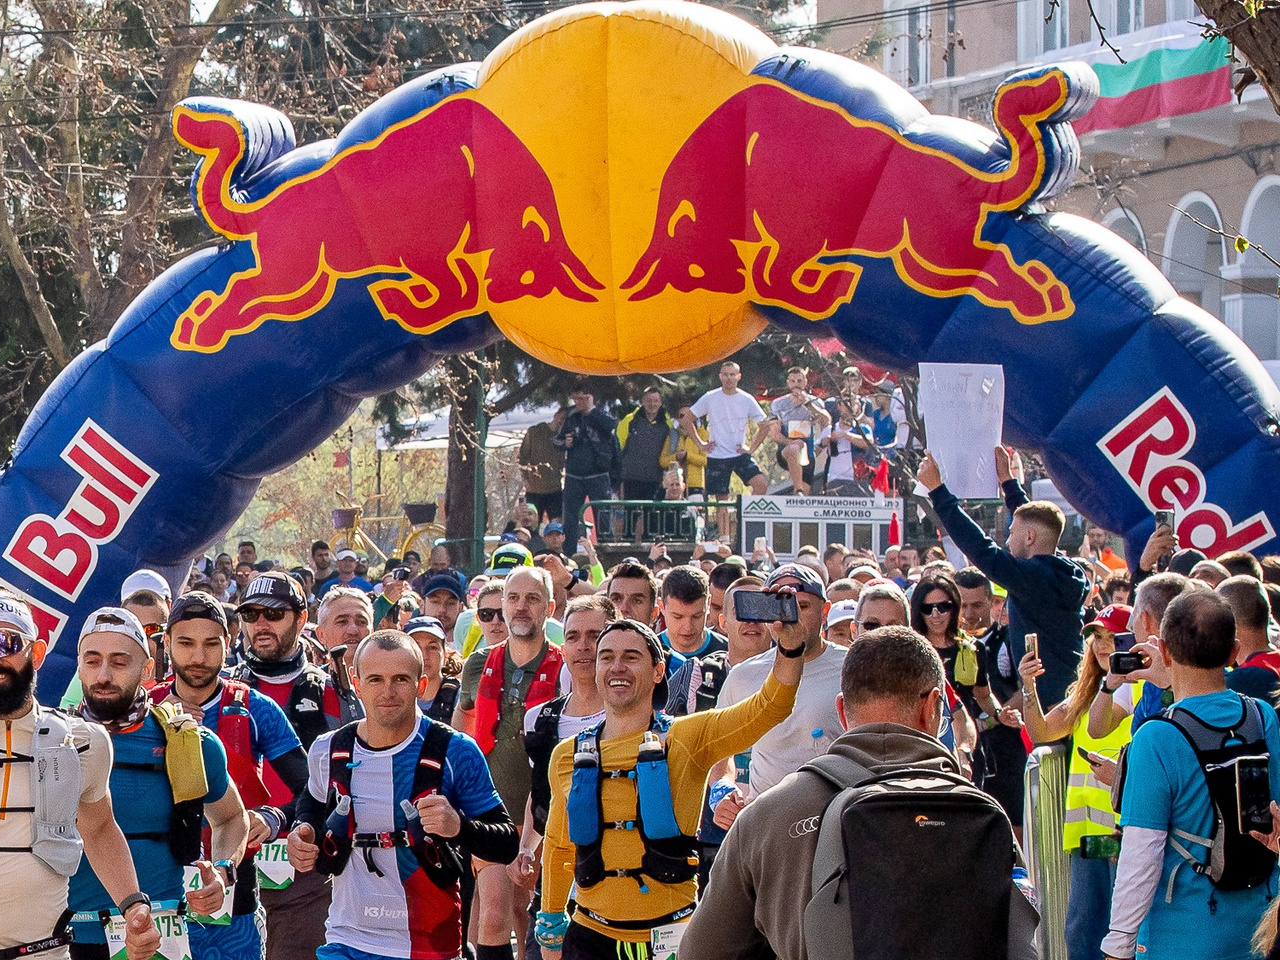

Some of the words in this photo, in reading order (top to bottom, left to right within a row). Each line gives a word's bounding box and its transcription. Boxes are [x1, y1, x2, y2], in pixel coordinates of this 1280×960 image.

[1102, 392, 1271, 559] Red
[5, 423, 156, 599] Bull
[785, 499, 868, 508] ИНФОРМАЦИОННО
[814, 510, 871, 518] с.МАРКОВО
[52, 757, 60, 782] KIPRUN
[154, 915, 183, 938] 175
